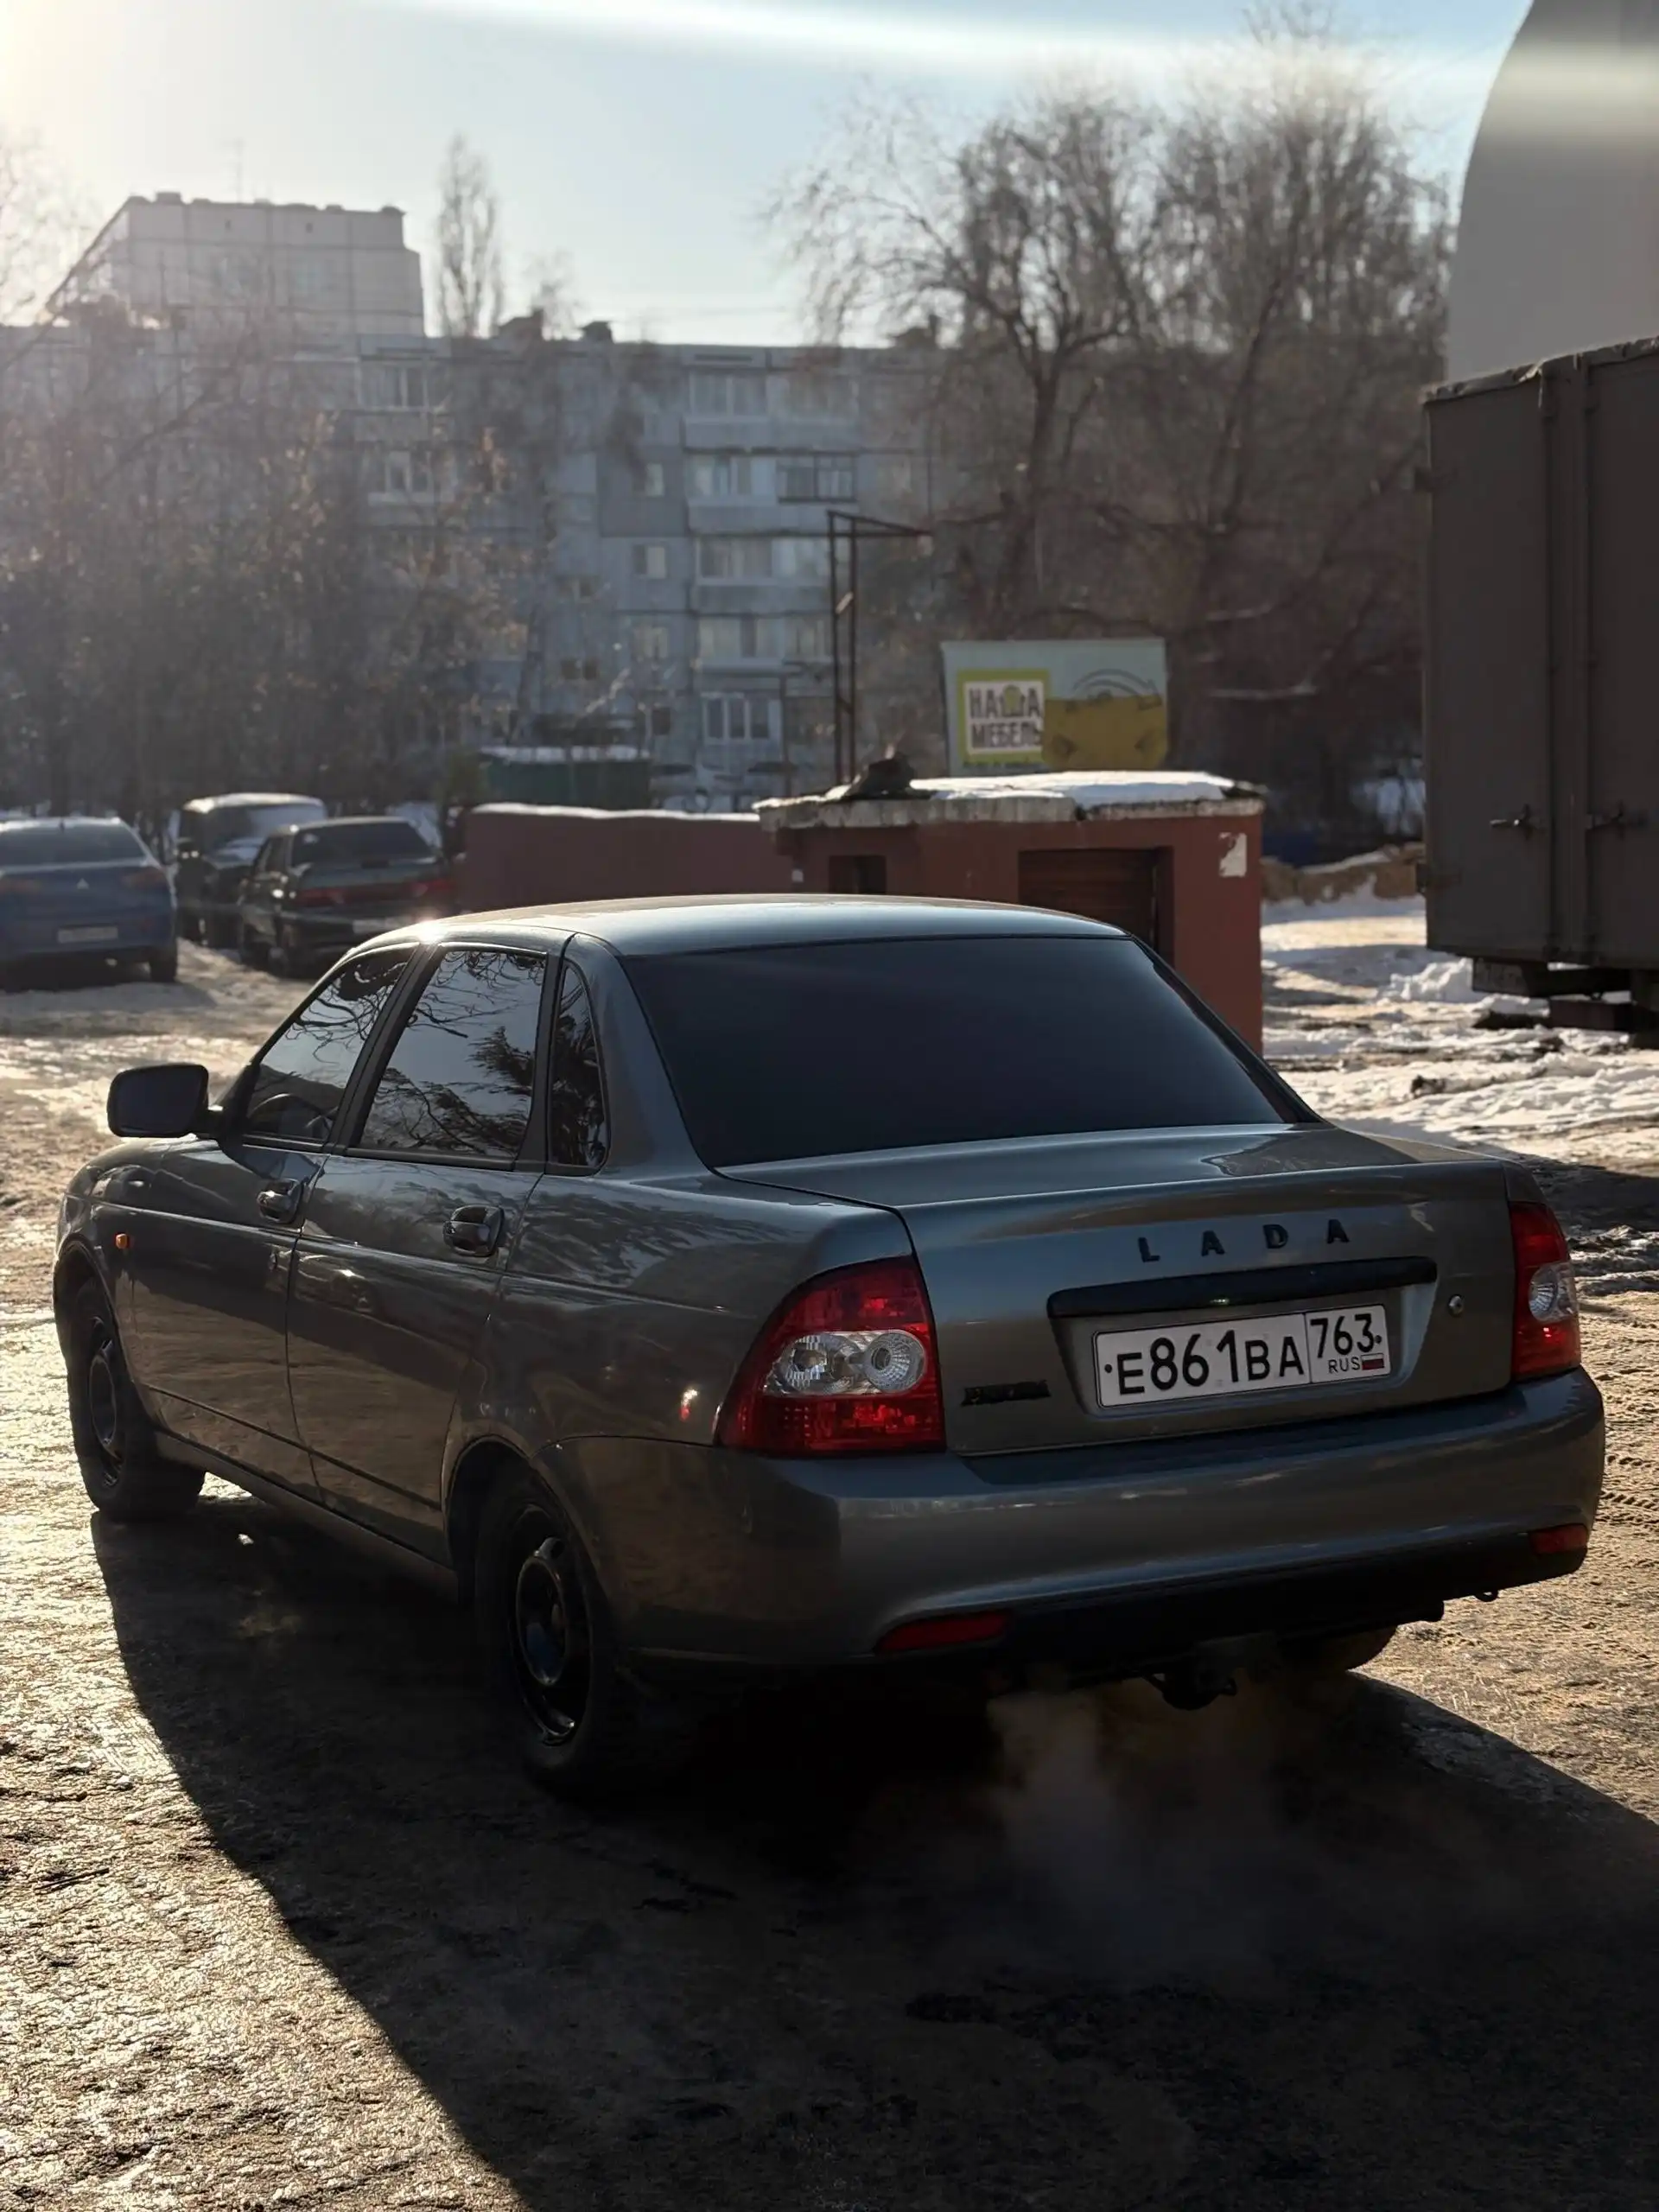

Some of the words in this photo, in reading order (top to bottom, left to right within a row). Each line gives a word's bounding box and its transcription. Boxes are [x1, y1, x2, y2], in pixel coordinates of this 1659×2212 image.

[1138, 1219, 1350, 1262] LADA
[1310, 1313, 1375, 1358] 763
[1328, 1357, 1361, 1374] RUS
